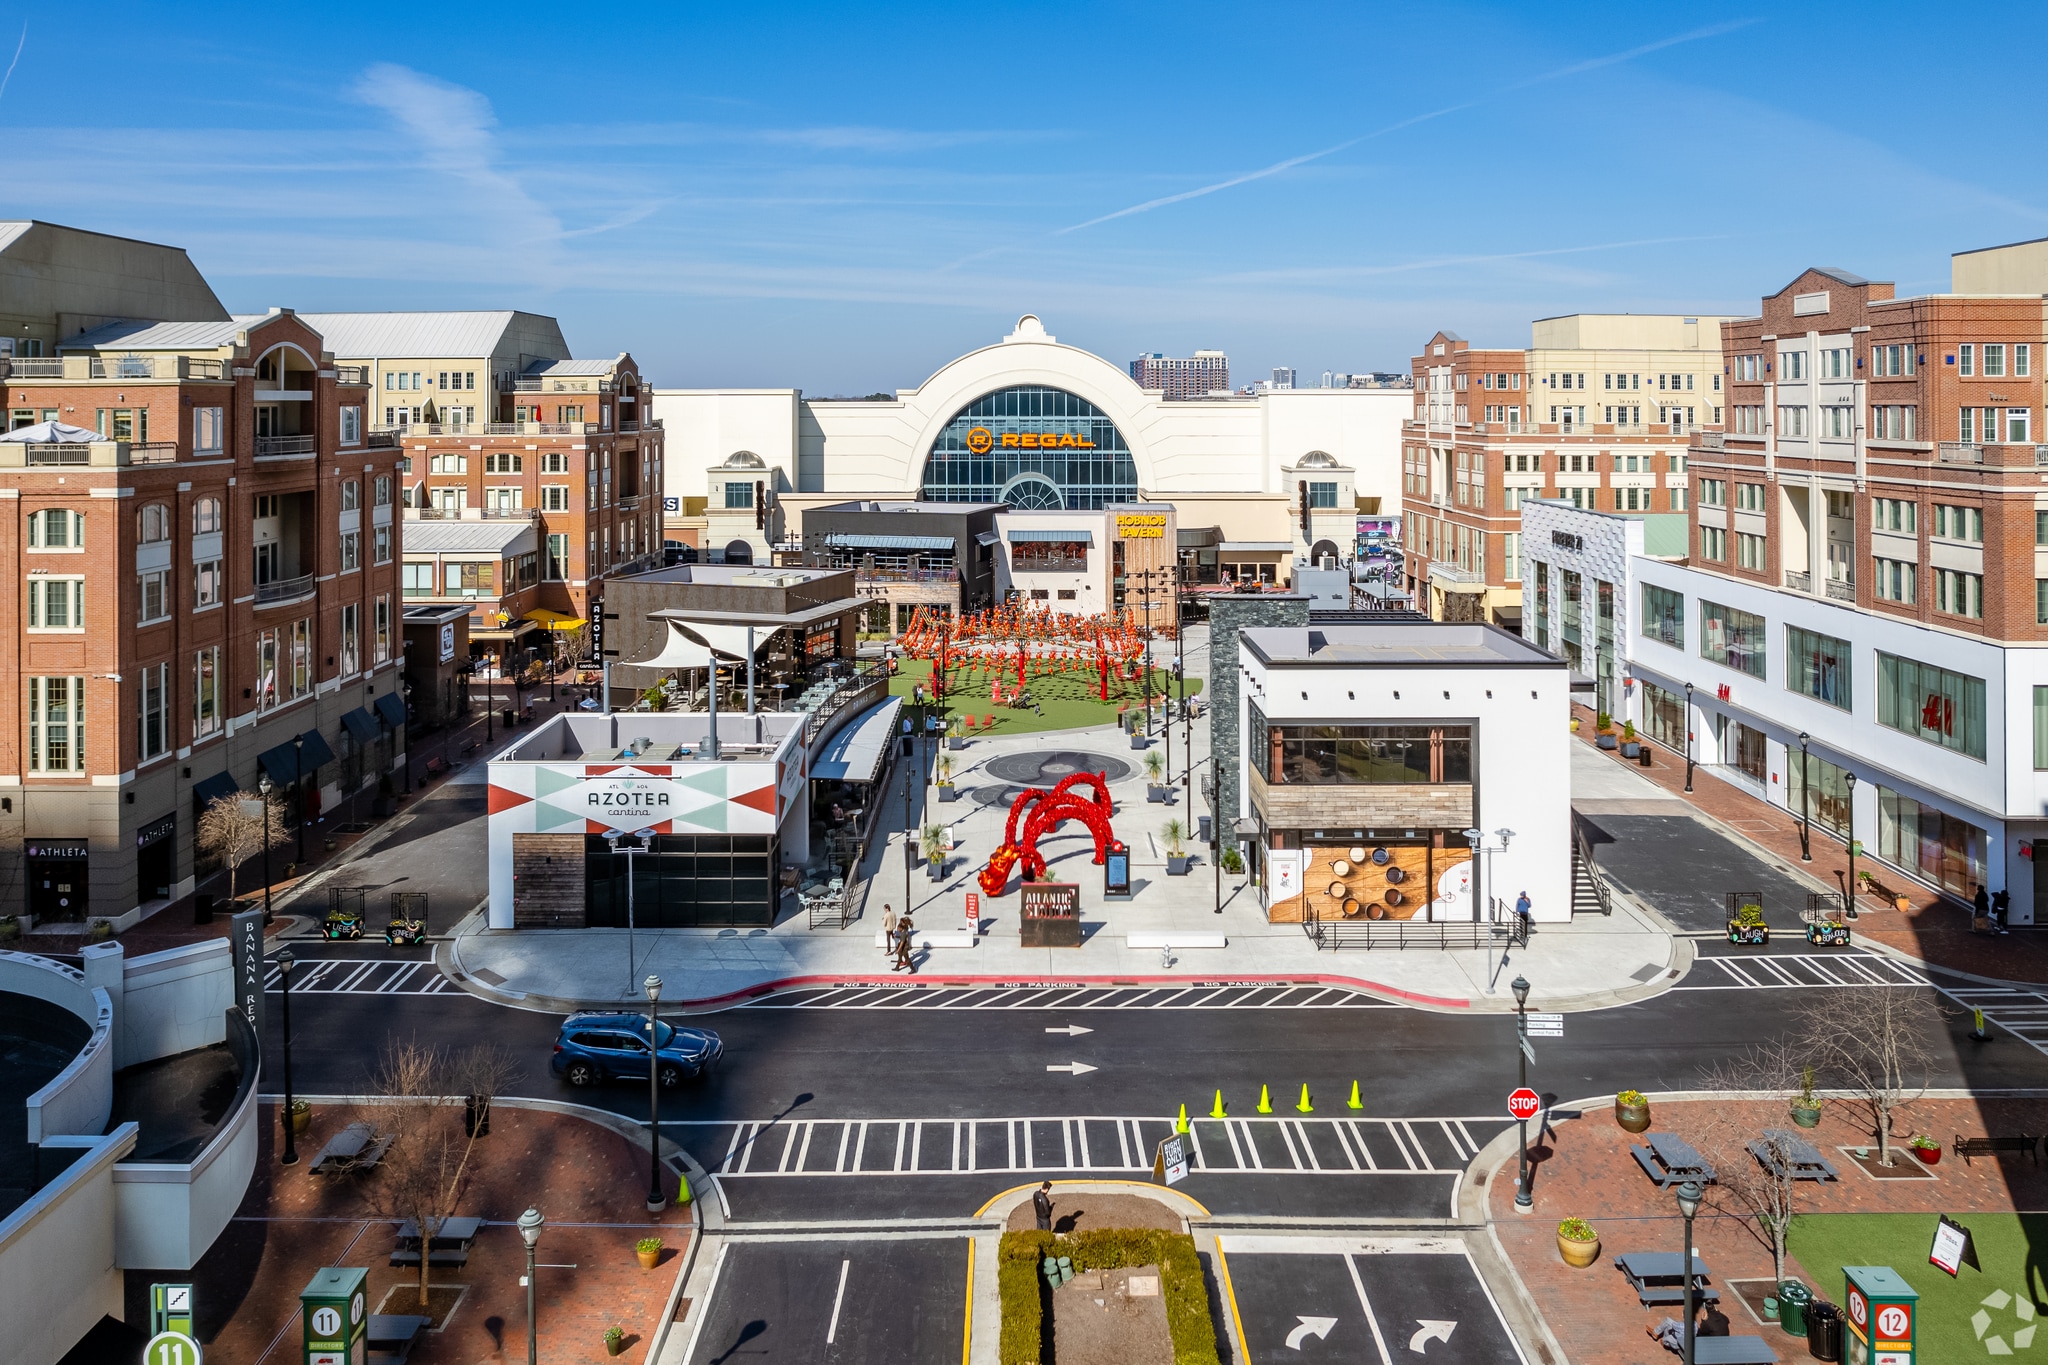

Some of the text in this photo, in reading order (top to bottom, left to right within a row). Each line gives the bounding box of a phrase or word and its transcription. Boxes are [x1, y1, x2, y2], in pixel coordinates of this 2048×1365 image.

[1002, 433, 1095, 448] REGAL
[1116, 515, 1166, 527] HOBNOB
[1119, 527, 1163, 538] TAVERN
[588, 792, 669, 806] AZOTEA
[607, 807, 651, 816] cantina
[144, 821, 174, 842] ATHLETA
[39, 847, 87, 857] ATHLETA
[1026, 892, 1071, 904] ATLANTIC
[1026, 904, 1071, 919] STATION
[332, 922, 351, 933] LIEBE
[1740, 928, 1764, 940] LAUGH
[245, 922, 256, 985] BANANA
[1511, 1098, 1537, 1110] STOP
[1164, 1138, 1180, 1151] RIGHT
[1165, 1146, 1181, 1158] TURN
[1166, 1152, 1182, 1167] ONLY
[354, 1298, 361, 1320] 11
[1852, 1296, 1863, 1322] 12
[318, 1313, 333, 1331] 11
[1884, 1313, 1902, 1332] 12
[158, 1343, 183, 1365] 11
